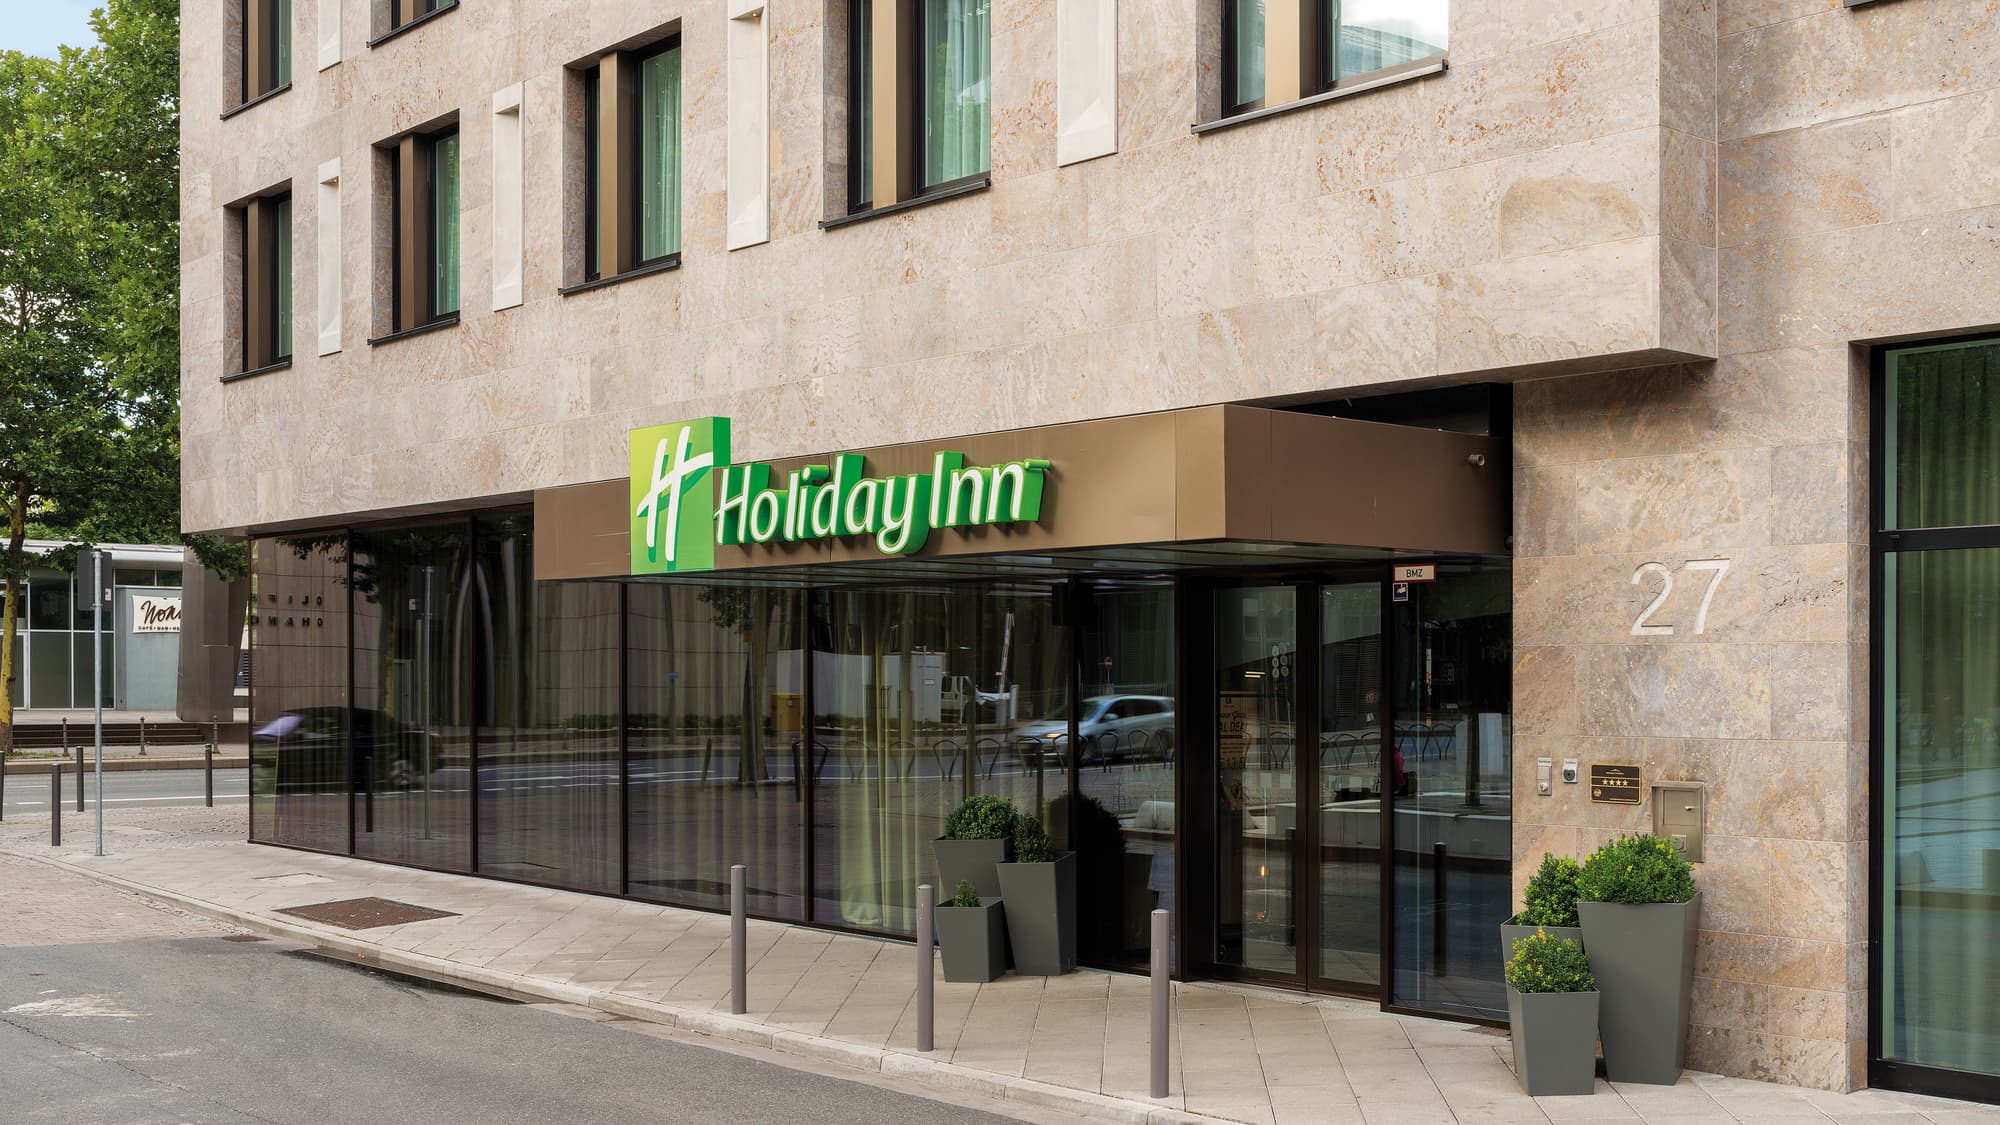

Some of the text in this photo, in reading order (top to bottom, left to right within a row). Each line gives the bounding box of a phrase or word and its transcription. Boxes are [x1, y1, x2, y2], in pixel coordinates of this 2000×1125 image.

[713, 451, 1032, 554] Holiday Inn
[1405, 568, 1424, 578] BMZ
[1630, 558, 1731, 636] 27
